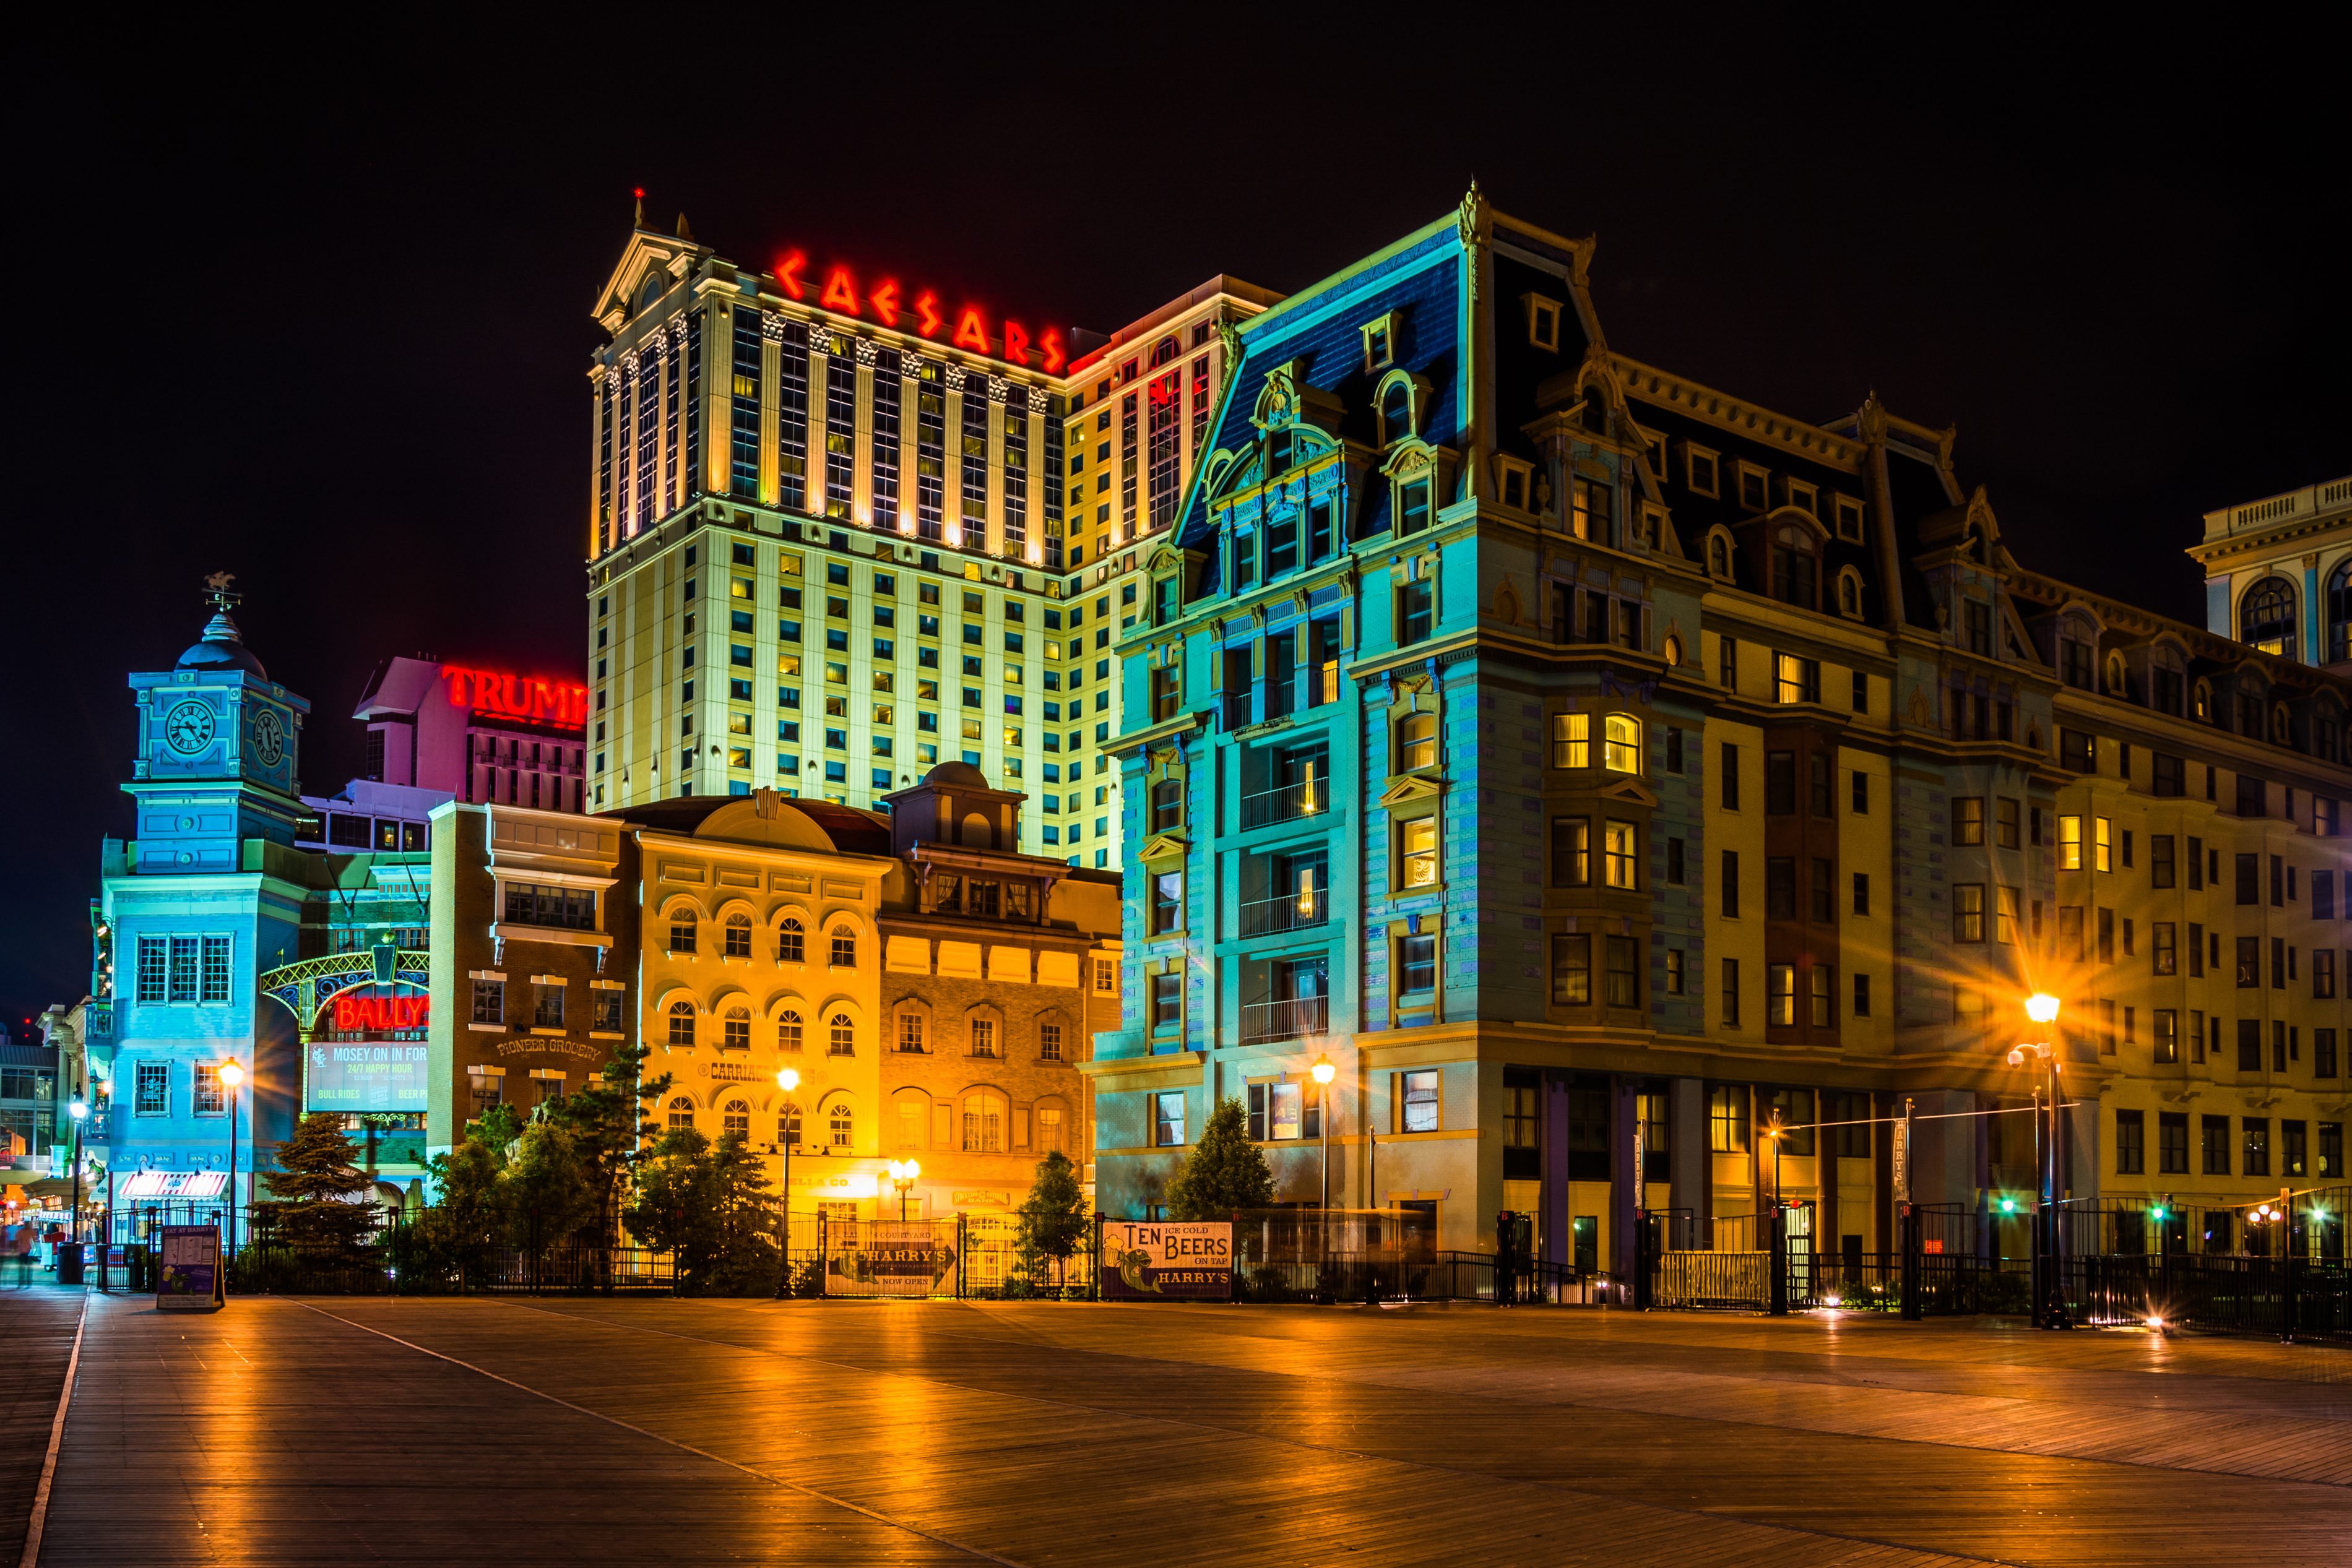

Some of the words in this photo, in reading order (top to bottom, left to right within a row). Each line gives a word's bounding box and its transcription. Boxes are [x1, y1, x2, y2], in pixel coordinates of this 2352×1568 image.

[776, 252, 1065, 371] CAESARS
[337, 994, 430, 1028] BALLY'
[333, 1048, 370, 1062] MOSEY
[373, 1048, 388, 1061] ON
[392, 1048, 402, 1061] IN
[406, 1047, 427, 1061] FOR
[496, 1039, 546, 1057] PIONEER
[550, 1039, 602, 1061] GROCERY
[347, 1064, 364, 1074] 24/7
[366, 1064, 390, 1074] HAPPY
[392, 1064, 412, 1074] HOUR
[711, 1062, 770, 1082] CARRIAGE
[318, 1089, 336, 1099] BULL
[338, 1089, 360, 1099] RIDES
[399, 1089, 418, 1099] BEER
[1771, 1208, 1778, 1218] B
[1903, 1206, 1909, 1216] B
[2031, 1202, 2038, 1213] B
[1502, 1211, 1508, 1220] B
[1637, 1210, 1643, 1219] B
[1124, 1225, 1161, 1249] TEN
[1165, 1235, 1227, 1260] BEERS
[867, 1251, 946, 1262] HARRY'S
[1158, 1272, 1229, 1283] HARRY'S
